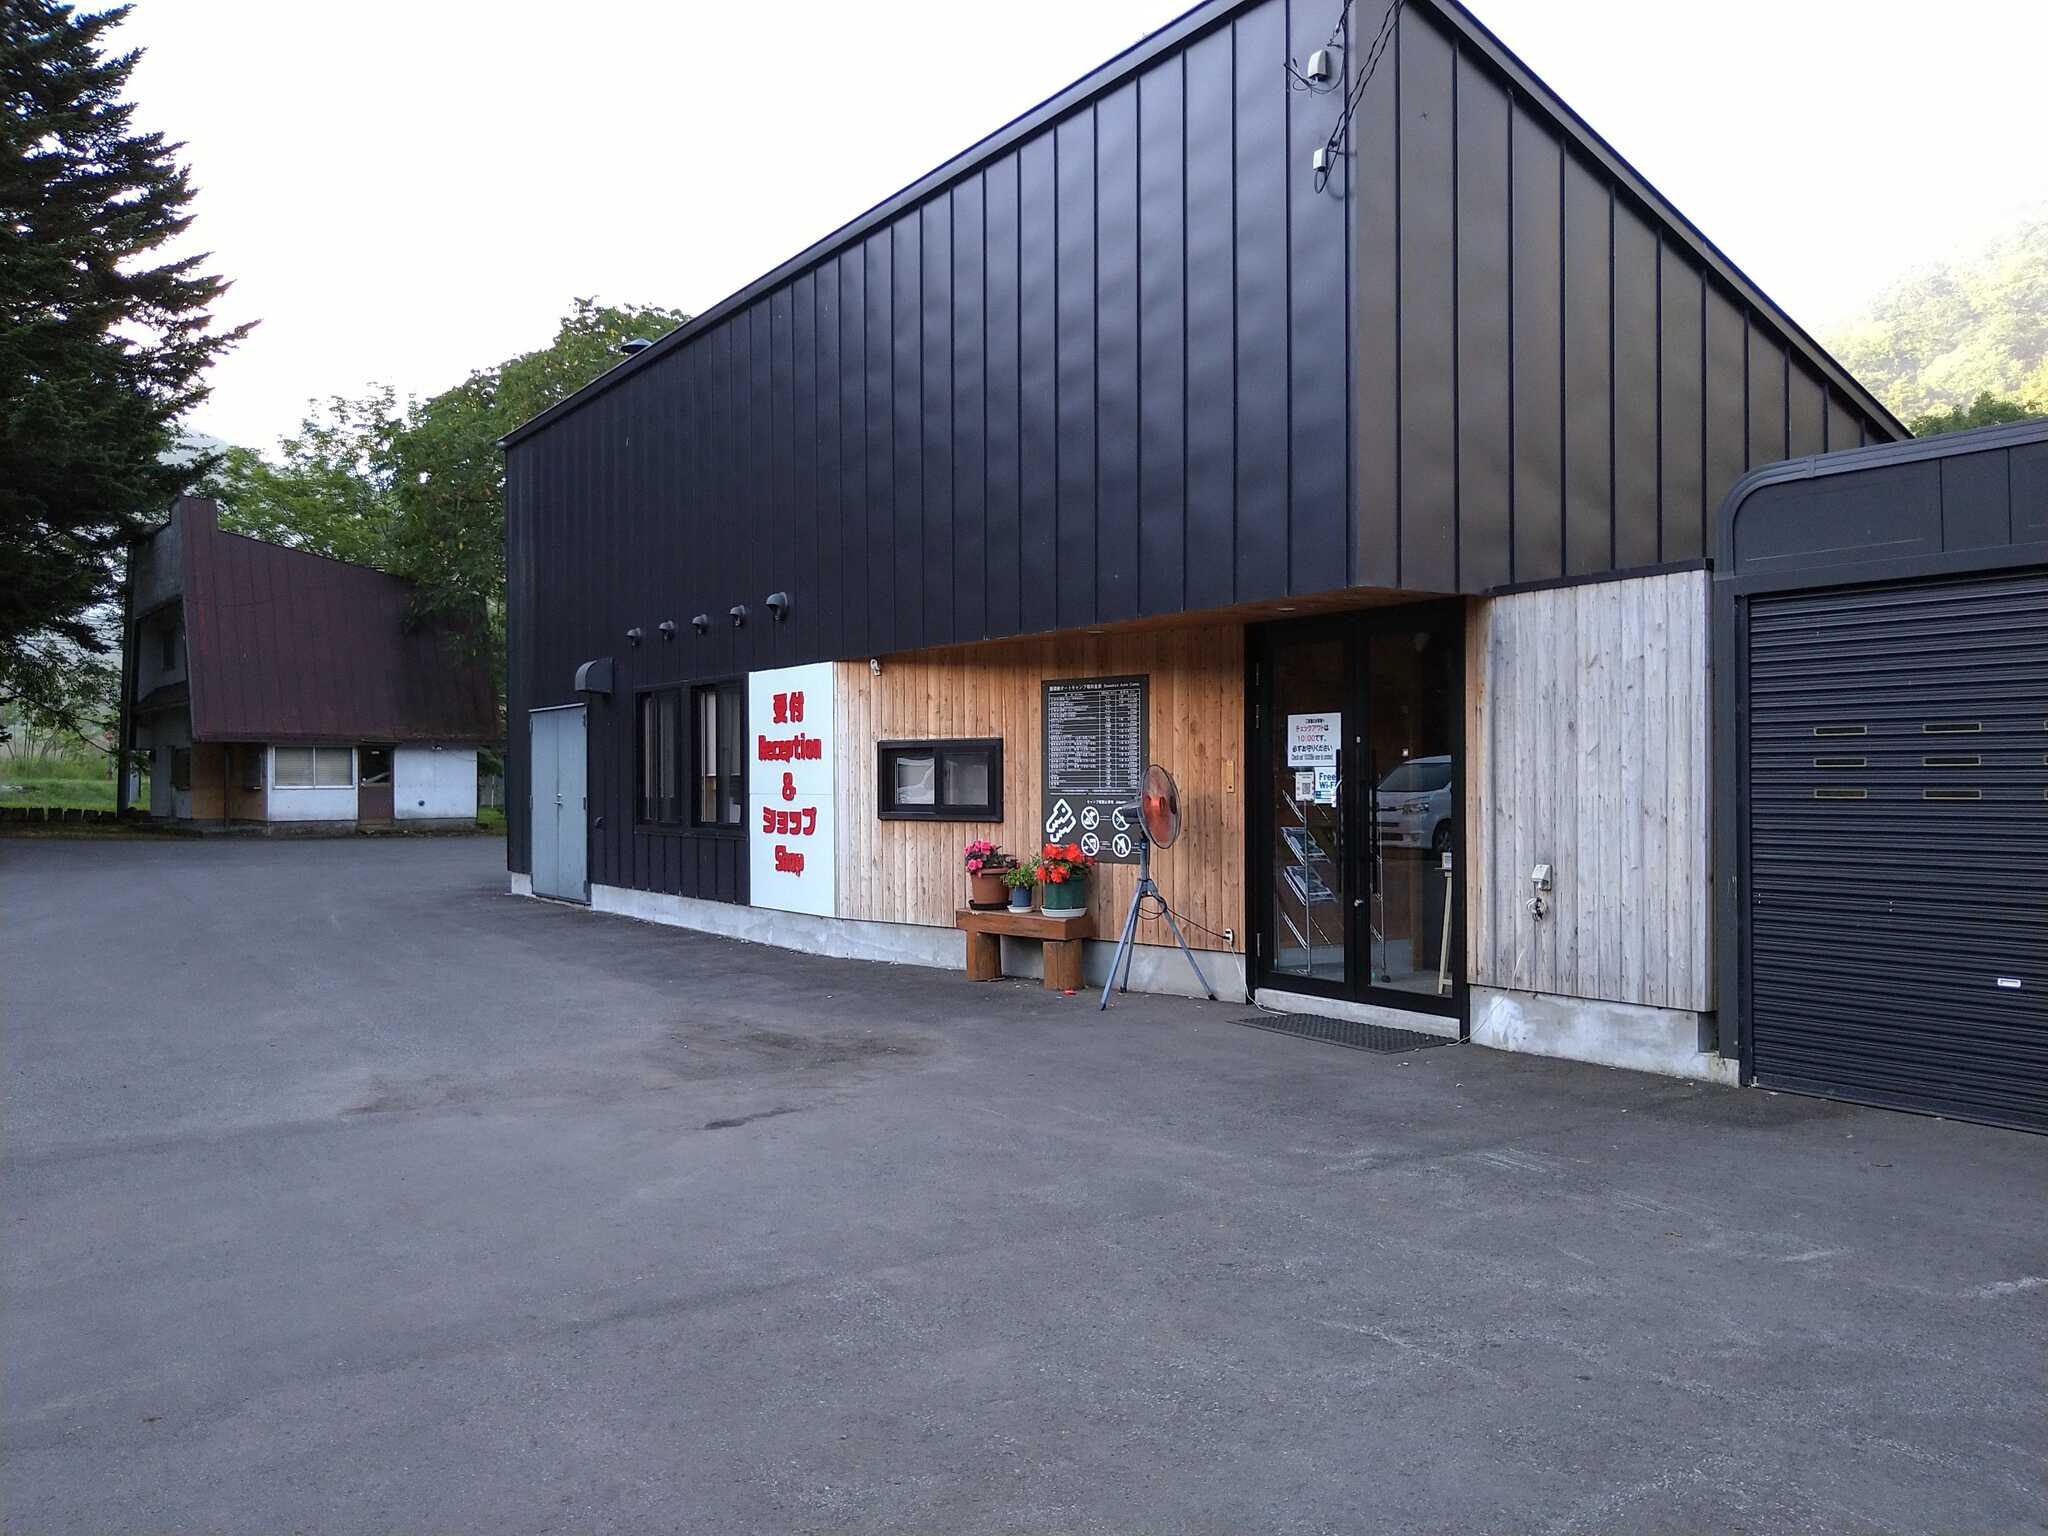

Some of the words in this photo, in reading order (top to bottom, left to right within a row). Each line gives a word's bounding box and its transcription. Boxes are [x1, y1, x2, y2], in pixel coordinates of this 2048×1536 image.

[772, 691, 805, 723] 受付
[758, 732, 822, 763] Reception
[781, 772, 797, 801] &
[1319, 772, 1336, 780] Free
[1319, 781, 1336, 789] Wi-F
[762, 806, 817, 836] ショップ
[774, 844, 805, 877] Shop
